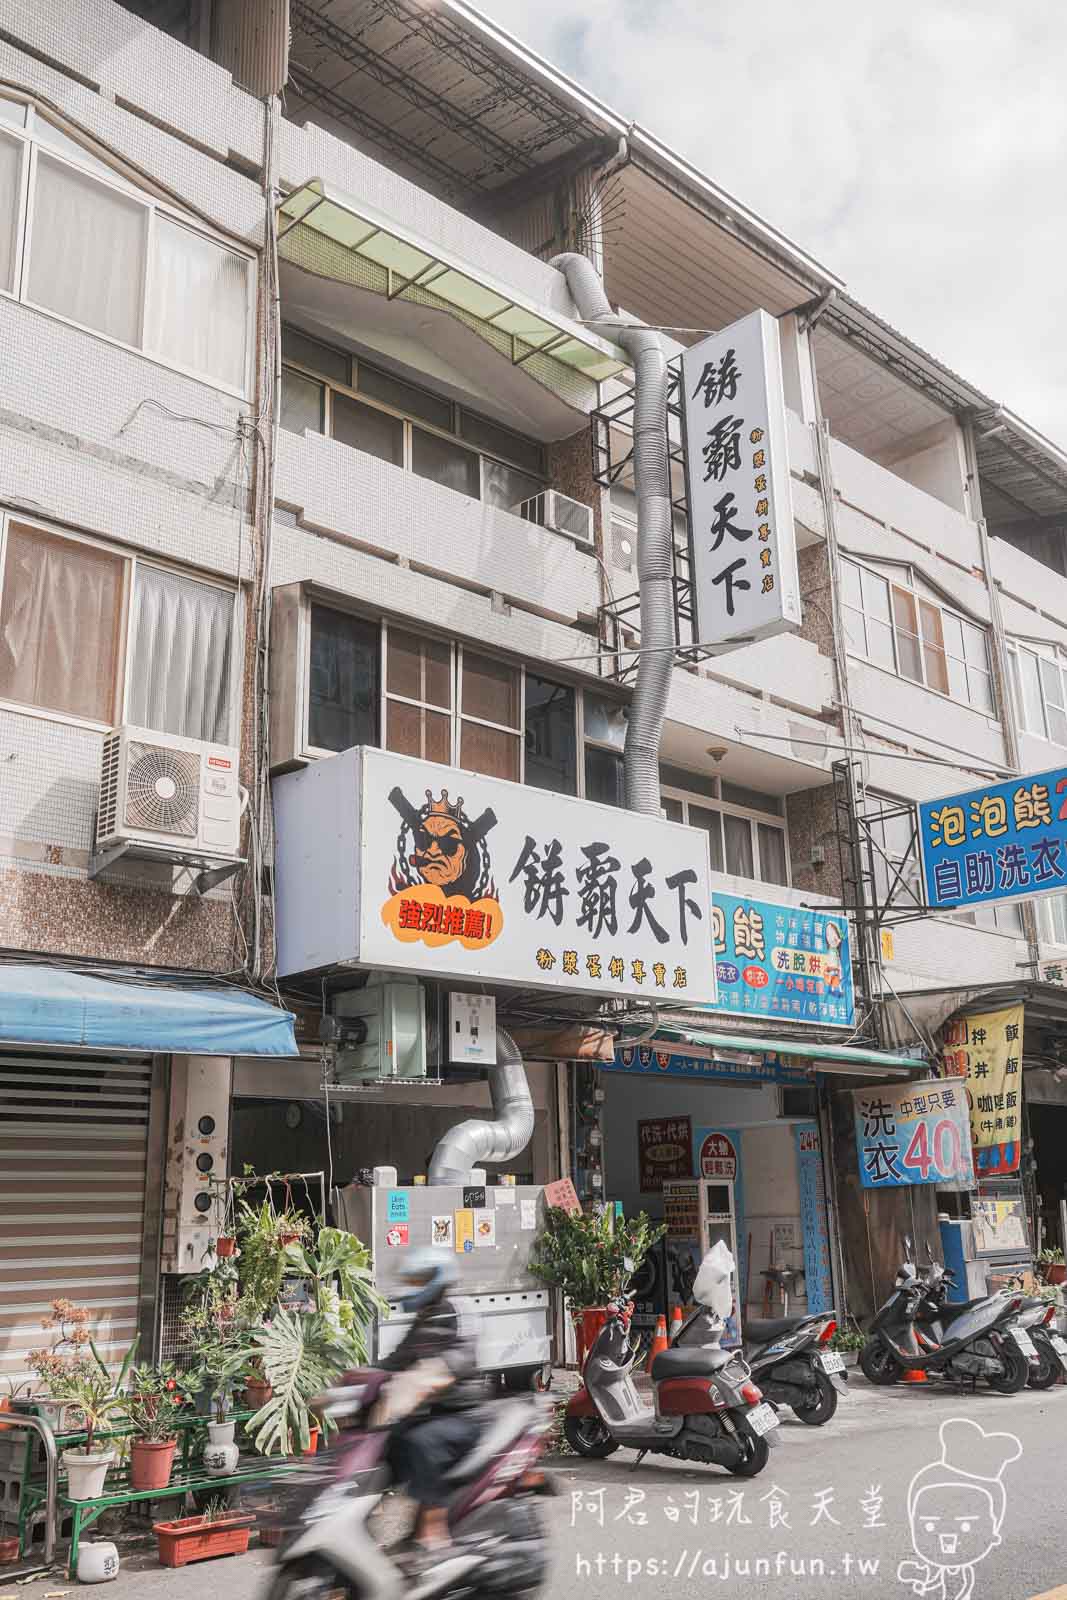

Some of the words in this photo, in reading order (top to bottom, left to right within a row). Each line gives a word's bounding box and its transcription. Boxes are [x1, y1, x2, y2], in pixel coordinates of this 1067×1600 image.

[930, 784, 1052, 847] 泡泡熊
[934, 836, 1064, 902] 自助洗衣
[399, 899, 493, 940] 強烈推薦!
[536, 948, 688, 988] 粉漿蛋餅專賣店
[900, 1089, 956, 1118] 中型只要
[861, 1099, 902, 1182] 洗衣
[903, 1120, 961, 1179] 40
